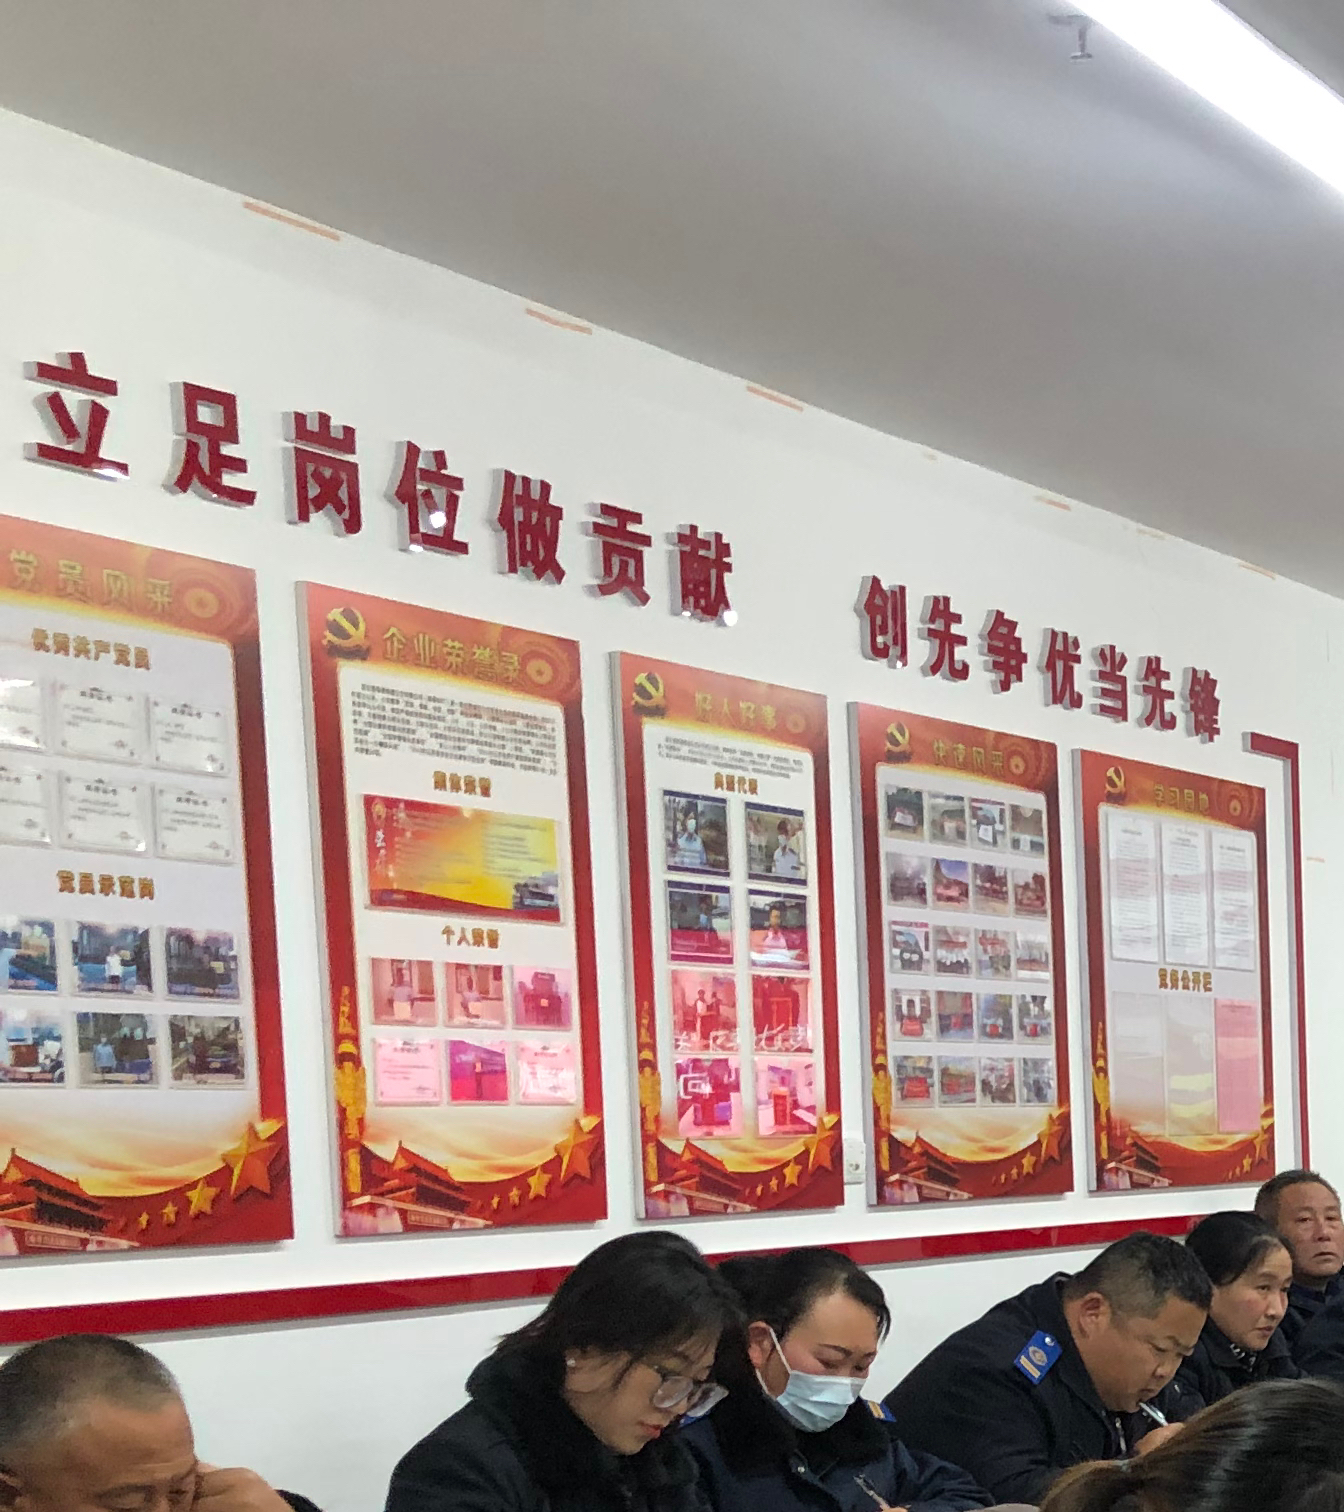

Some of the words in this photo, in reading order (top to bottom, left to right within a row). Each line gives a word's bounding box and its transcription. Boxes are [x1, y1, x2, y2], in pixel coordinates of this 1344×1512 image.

[25, 352, 737, 625] 立足岗位做贡献
[383, 627, 524, 688] 企业荣誉录
[857, 575, 1222, 743] 创先争优当先锋
